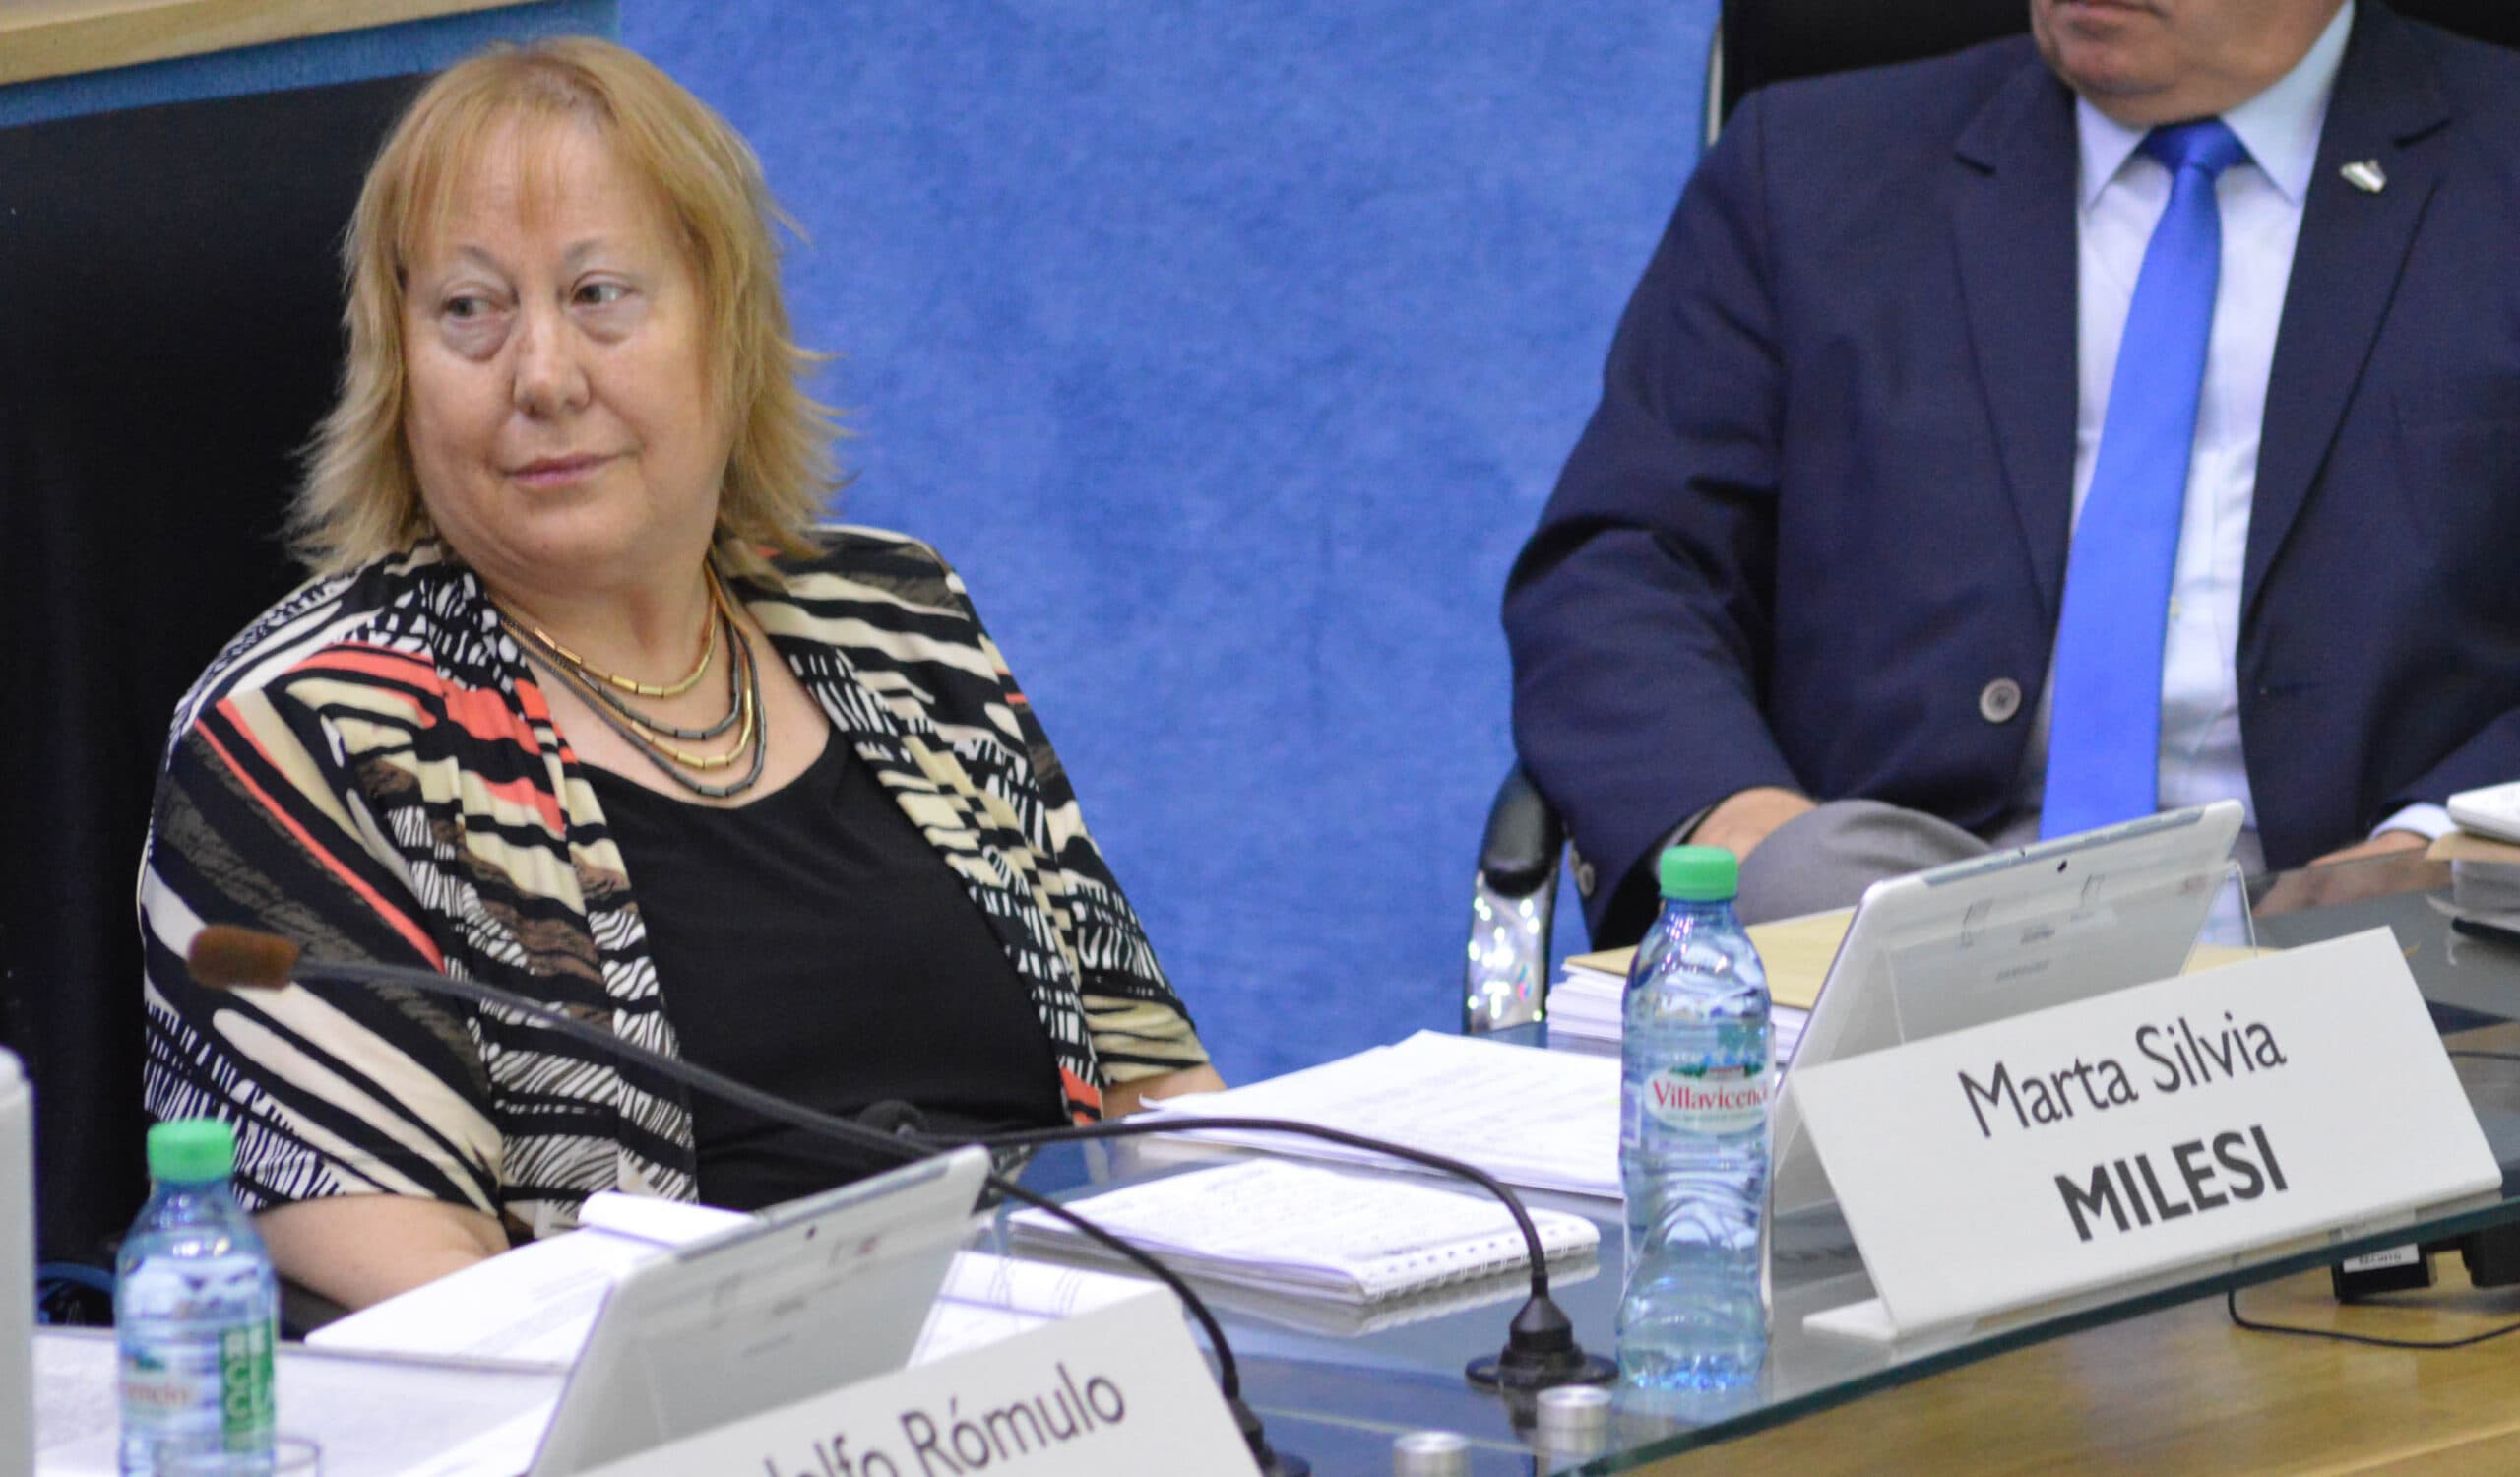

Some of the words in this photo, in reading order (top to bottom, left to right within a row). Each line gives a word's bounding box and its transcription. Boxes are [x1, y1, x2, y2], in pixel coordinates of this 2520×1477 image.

[1957, 1058, 2140, 1138] Marta
[2134, 1011, 2288, 1094] Silvia
[2054, 1124, 2289, 1243] MILESI
[900, 1362, 1125, 1477] Rómulo
